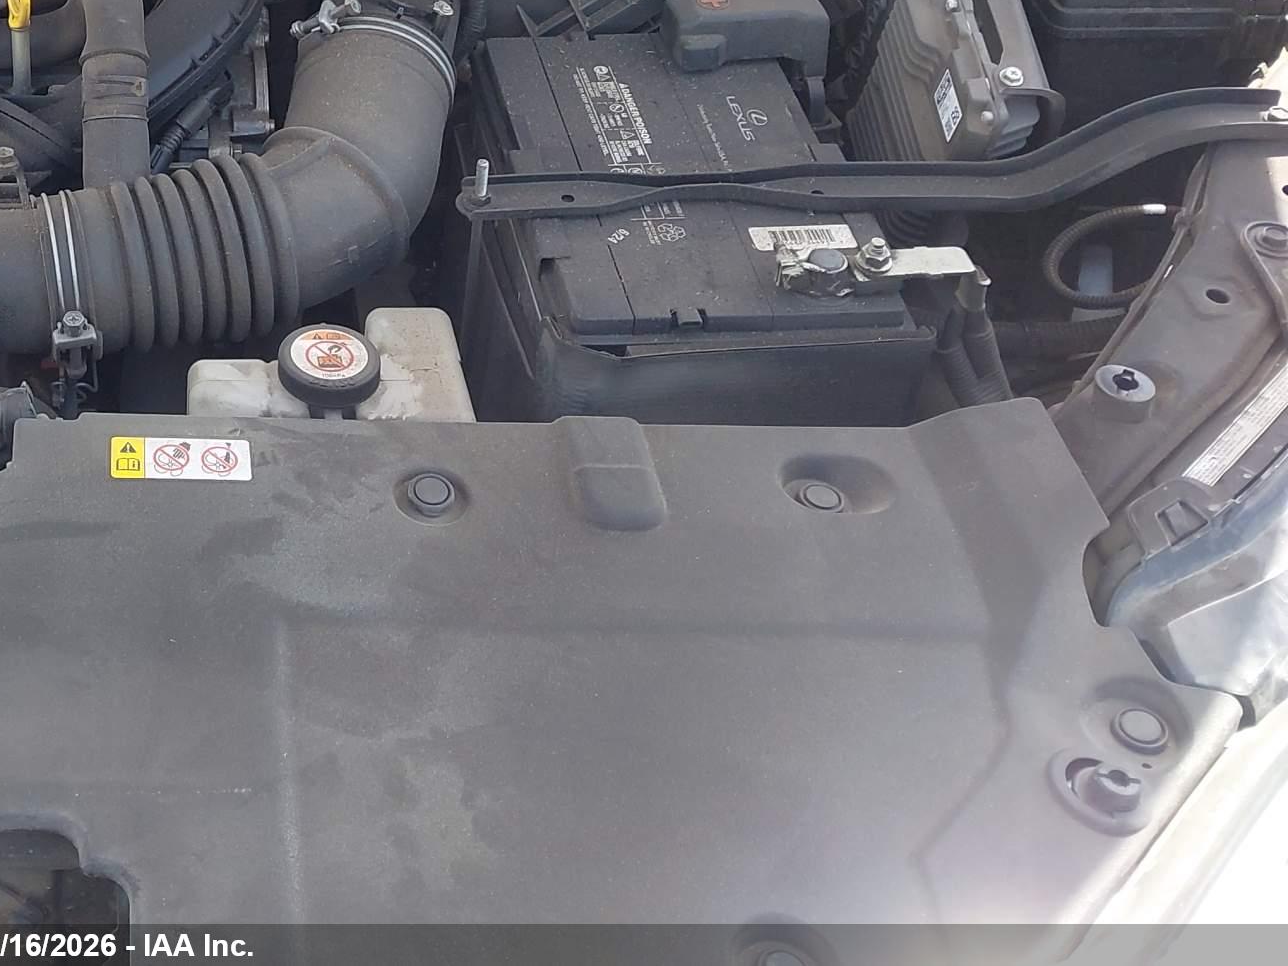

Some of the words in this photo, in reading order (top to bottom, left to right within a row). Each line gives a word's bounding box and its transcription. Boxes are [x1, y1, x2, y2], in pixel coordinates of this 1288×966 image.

[621, 88, 640, 116] DANGER
[633, 117, 652, 144] POISON
[726, 96, 755, 141] LEXUS
